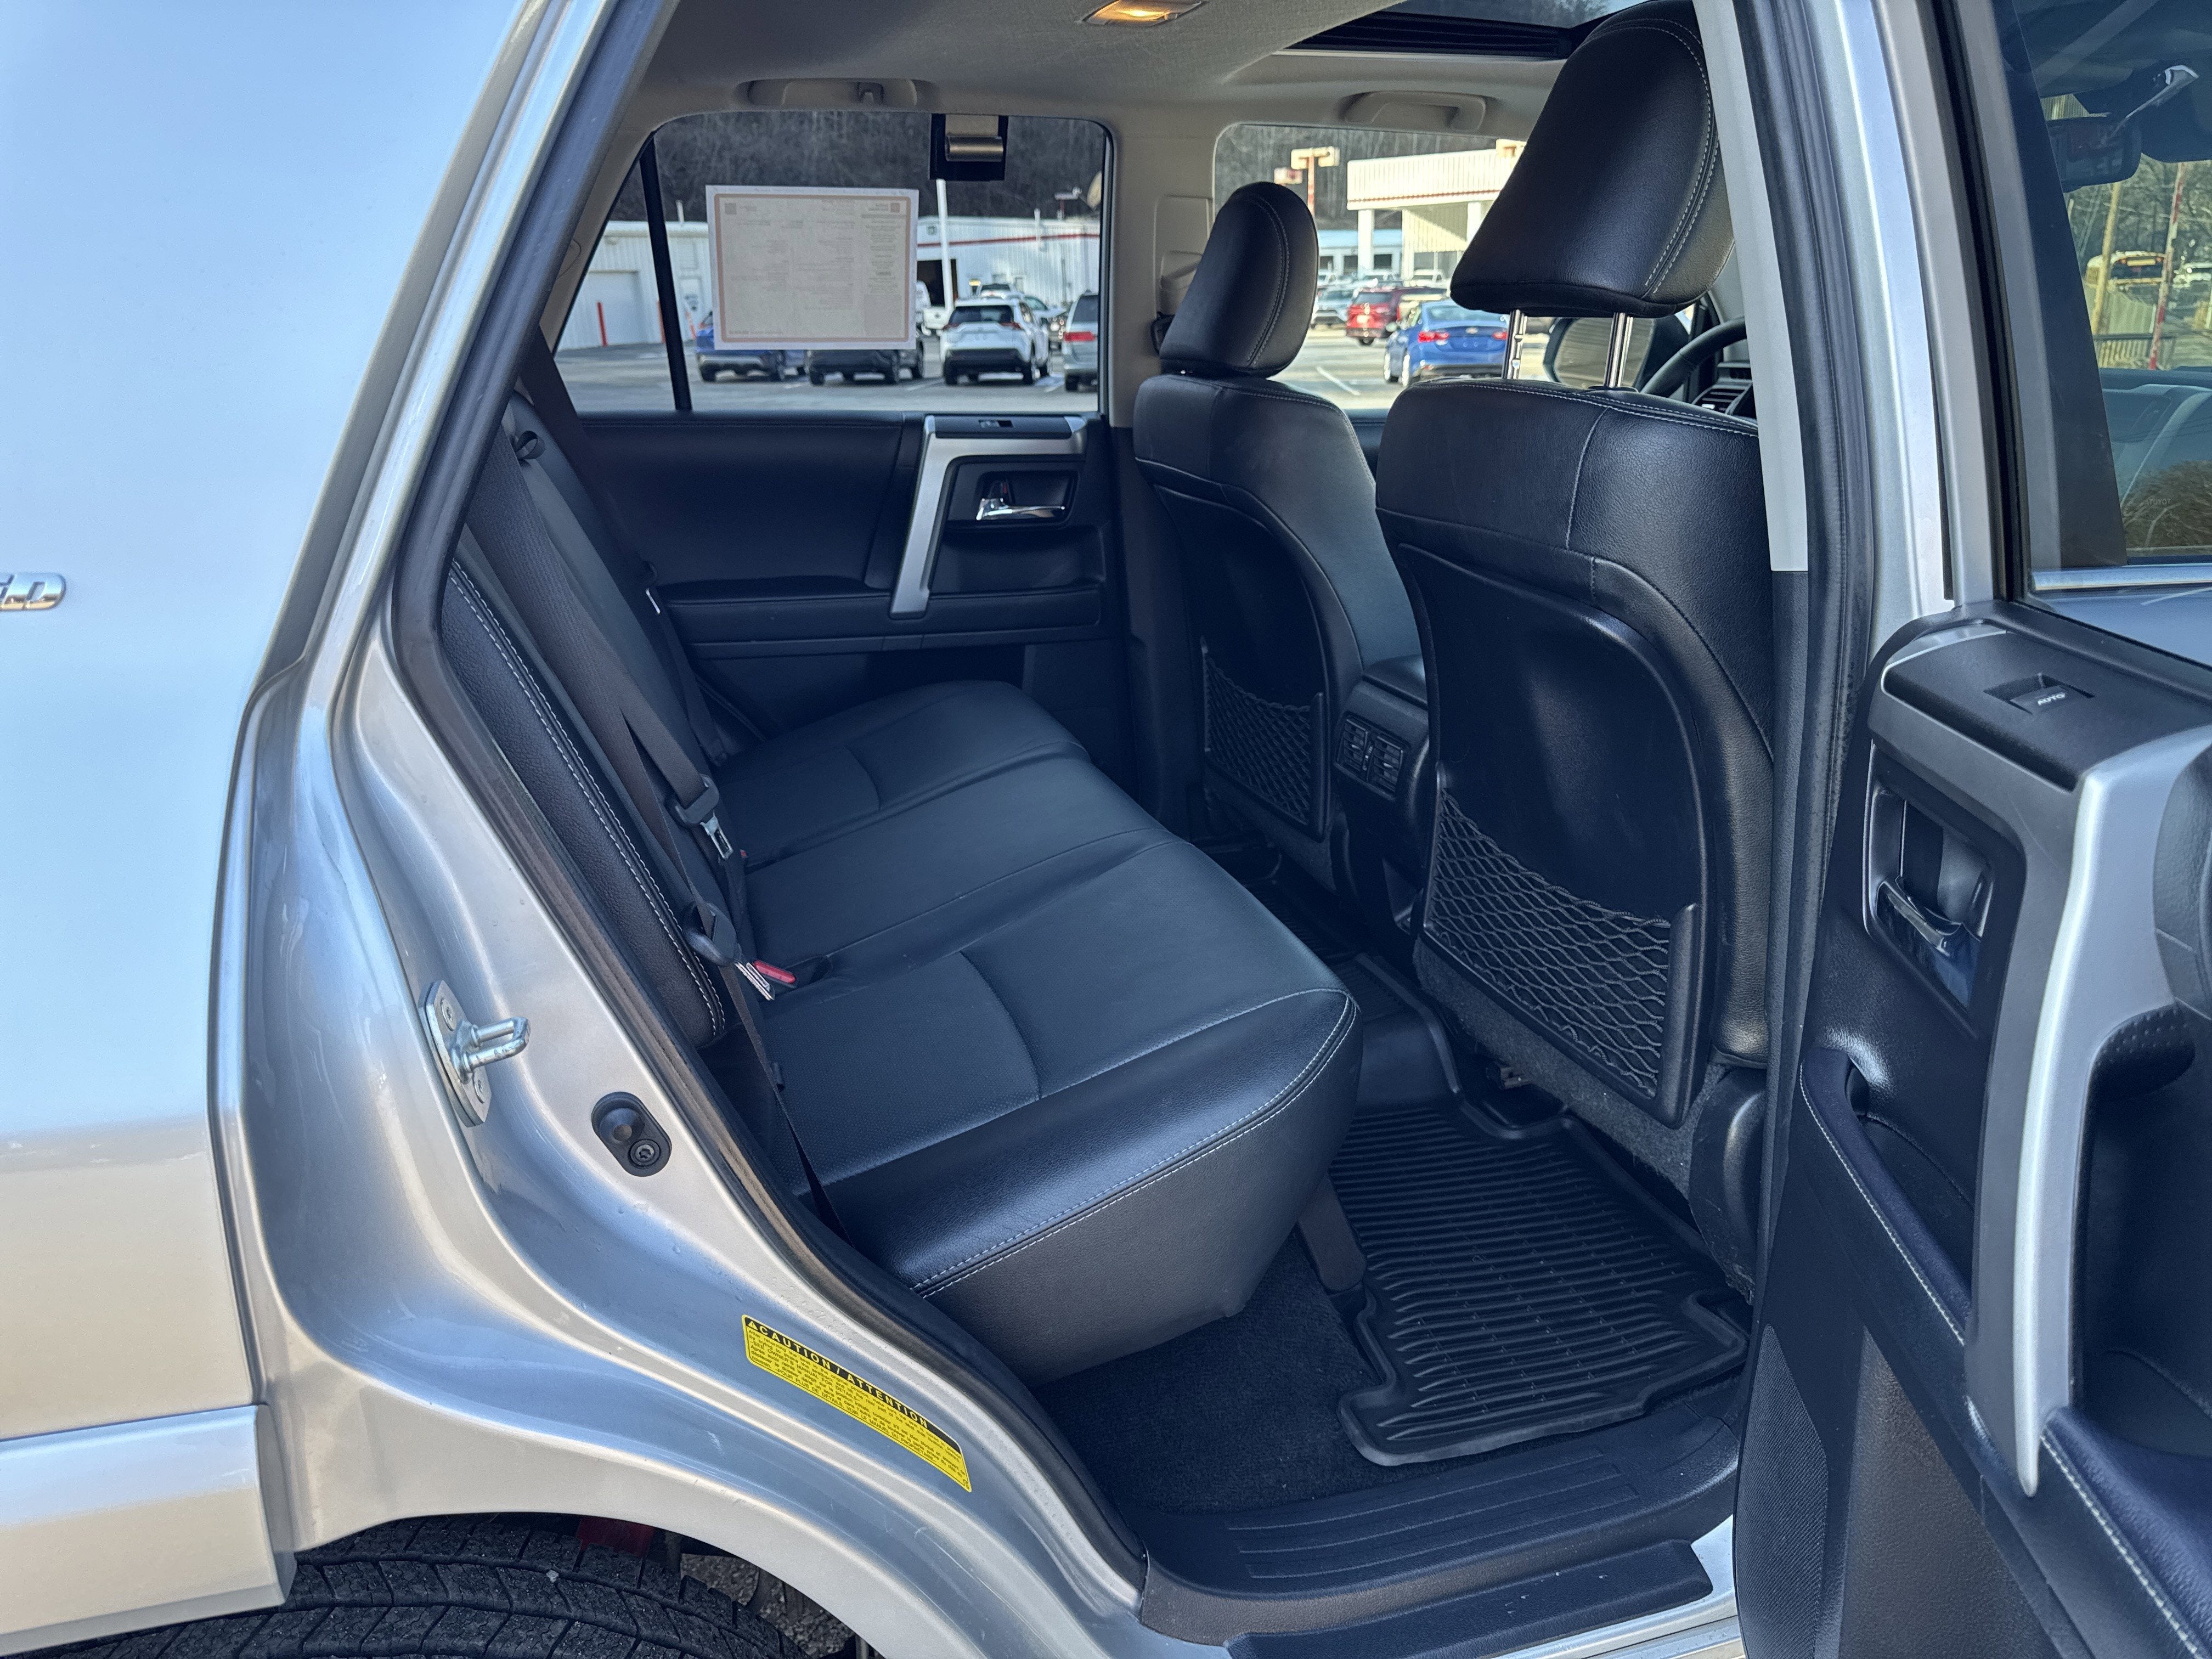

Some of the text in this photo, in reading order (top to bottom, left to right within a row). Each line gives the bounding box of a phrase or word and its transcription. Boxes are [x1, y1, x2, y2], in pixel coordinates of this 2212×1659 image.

[2037, 692, 2066, 706] AUTO
[759, 1326, 831, 1370] CAUTION
[847, 1374, 928, 1429] ATTENTION
[797, 1364, 819, 1379] MANUAL
